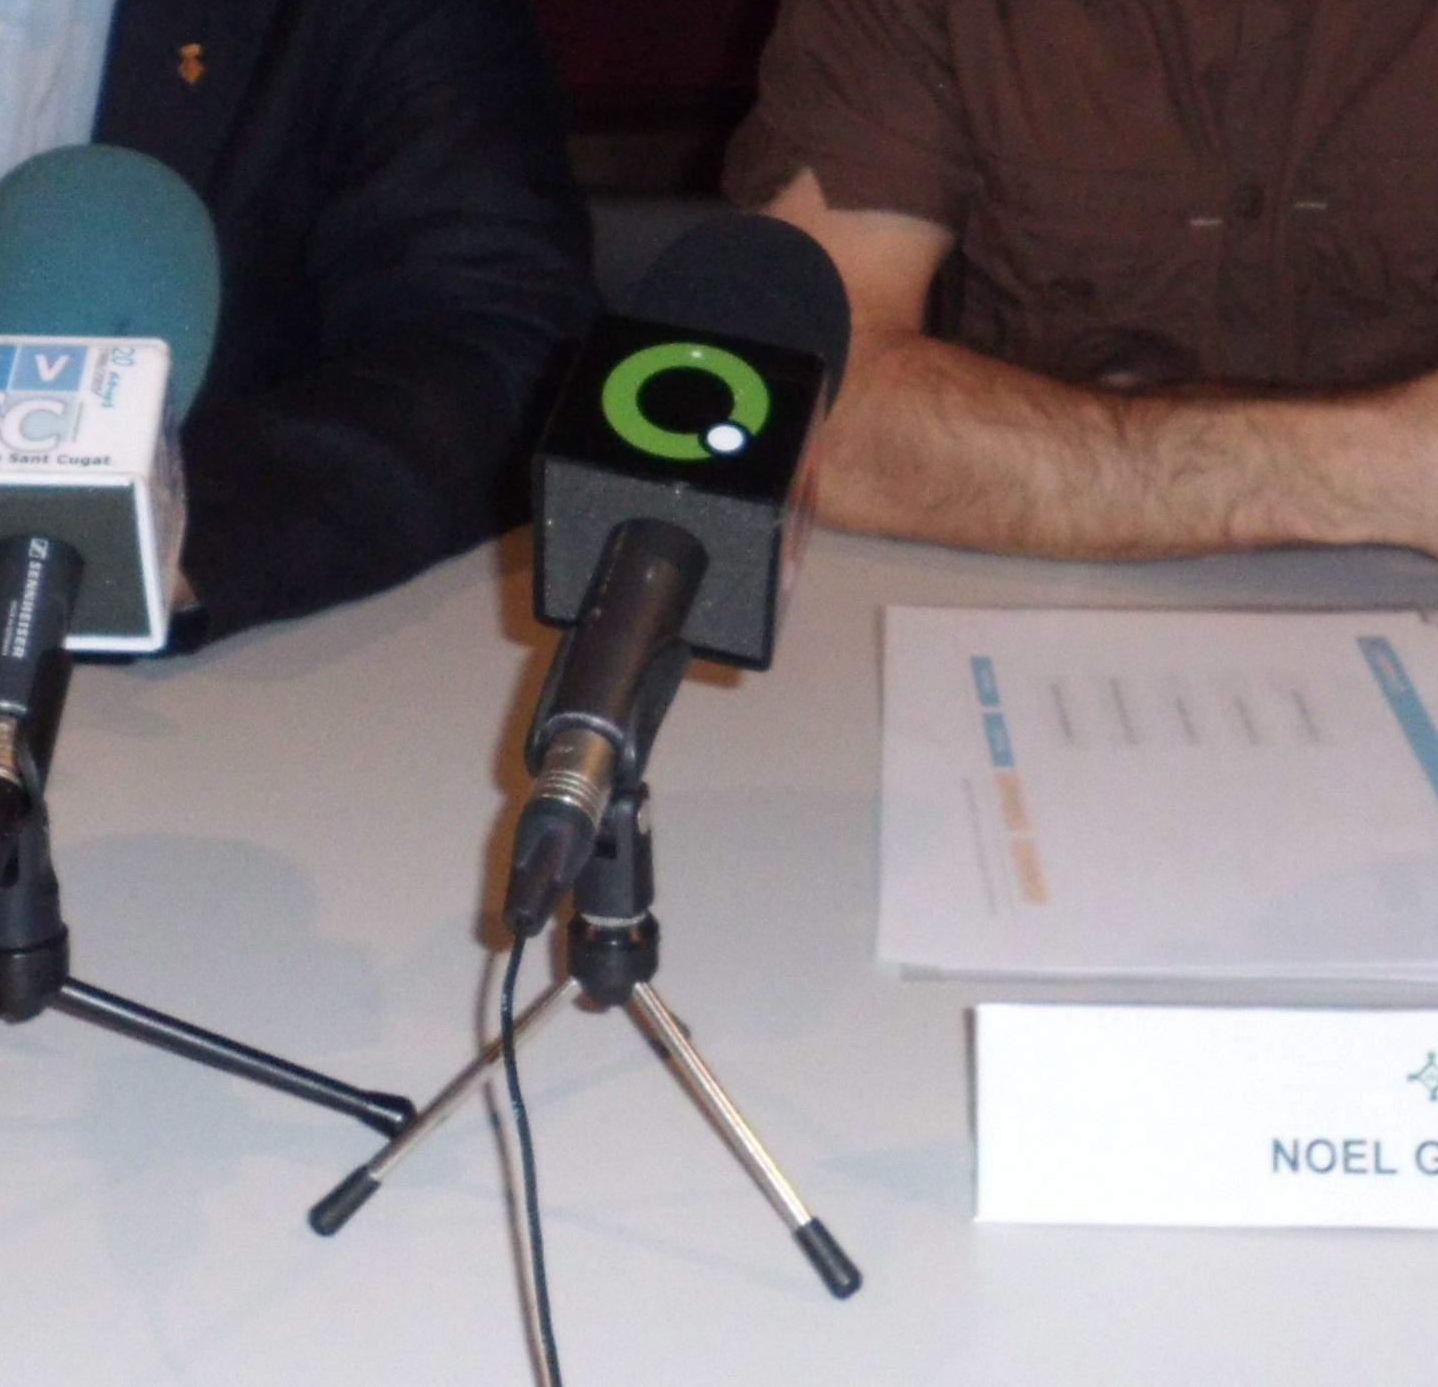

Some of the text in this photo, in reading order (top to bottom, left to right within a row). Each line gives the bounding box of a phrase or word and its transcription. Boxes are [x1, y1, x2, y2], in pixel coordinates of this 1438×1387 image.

[10, 453, 50, 464] Sant
[57, 454, 112, 467] Cugat
[12, 560, 42, 658] SENNHEISER
[1272, 1138, 1398, 1175] NOEL
